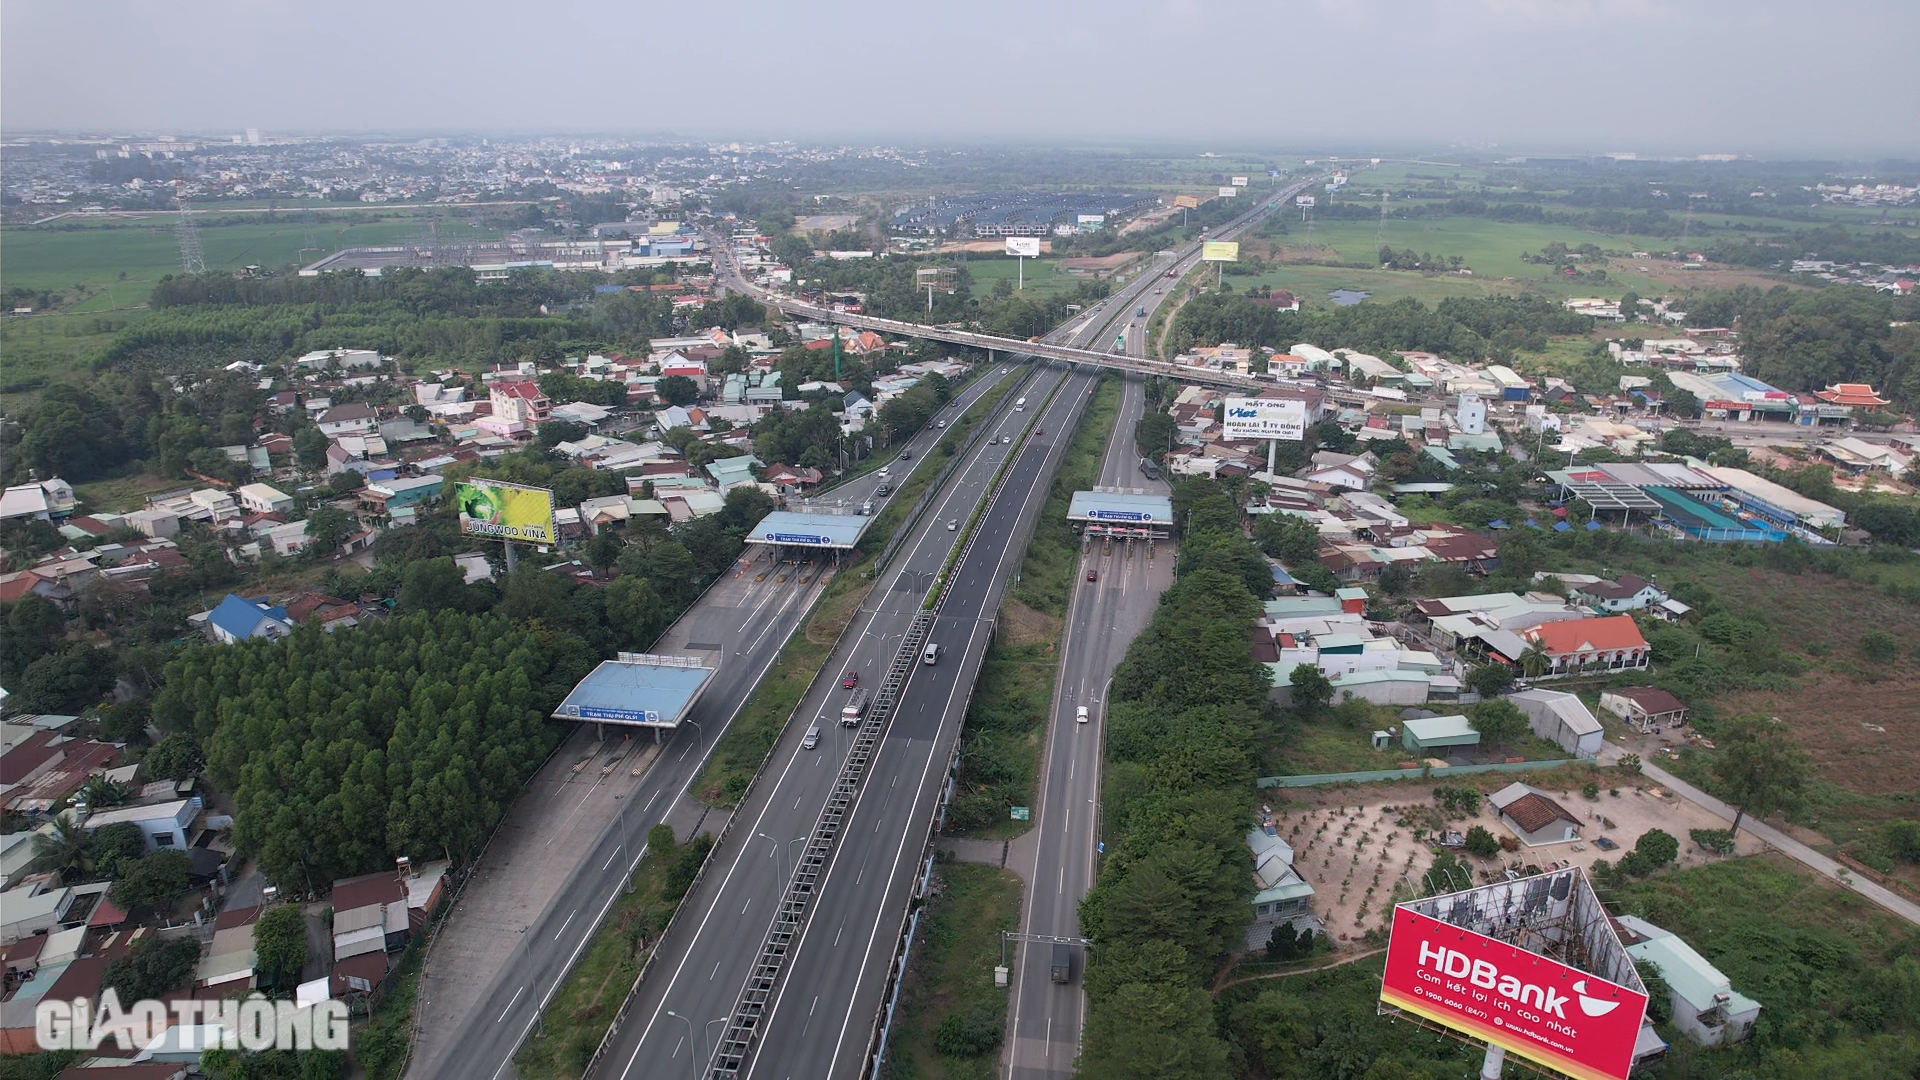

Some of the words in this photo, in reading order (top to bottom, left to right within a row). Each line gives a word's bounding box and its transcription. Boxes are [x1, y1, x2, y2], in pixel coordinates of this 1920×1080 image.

[1262, 420, 1268, 428] 1
[467, 521, 519, 536] JUNGWOO
[521, 528, 547, 539] VINA
[1416, 969, 1441, 985] Cam
[1446, 980, 1467, 995] kết
[1472, 989, 1488, 1003] lợi
[1493, 998, 1511, 1012] ích
[1517, 1009, 1541, 1023] cao
[1546, 1021, 1577, 1038] nhất
[1418, 940, 1570, 1020] HDBank
[1425, 991, 1442, 1002] 1900
[1444, 999, 1463, 1010] 6060
[1465, 1006, 1488, 1019] (24/7)
[1505, 1022, 1574, 1053] www.hdbank.com.vn
